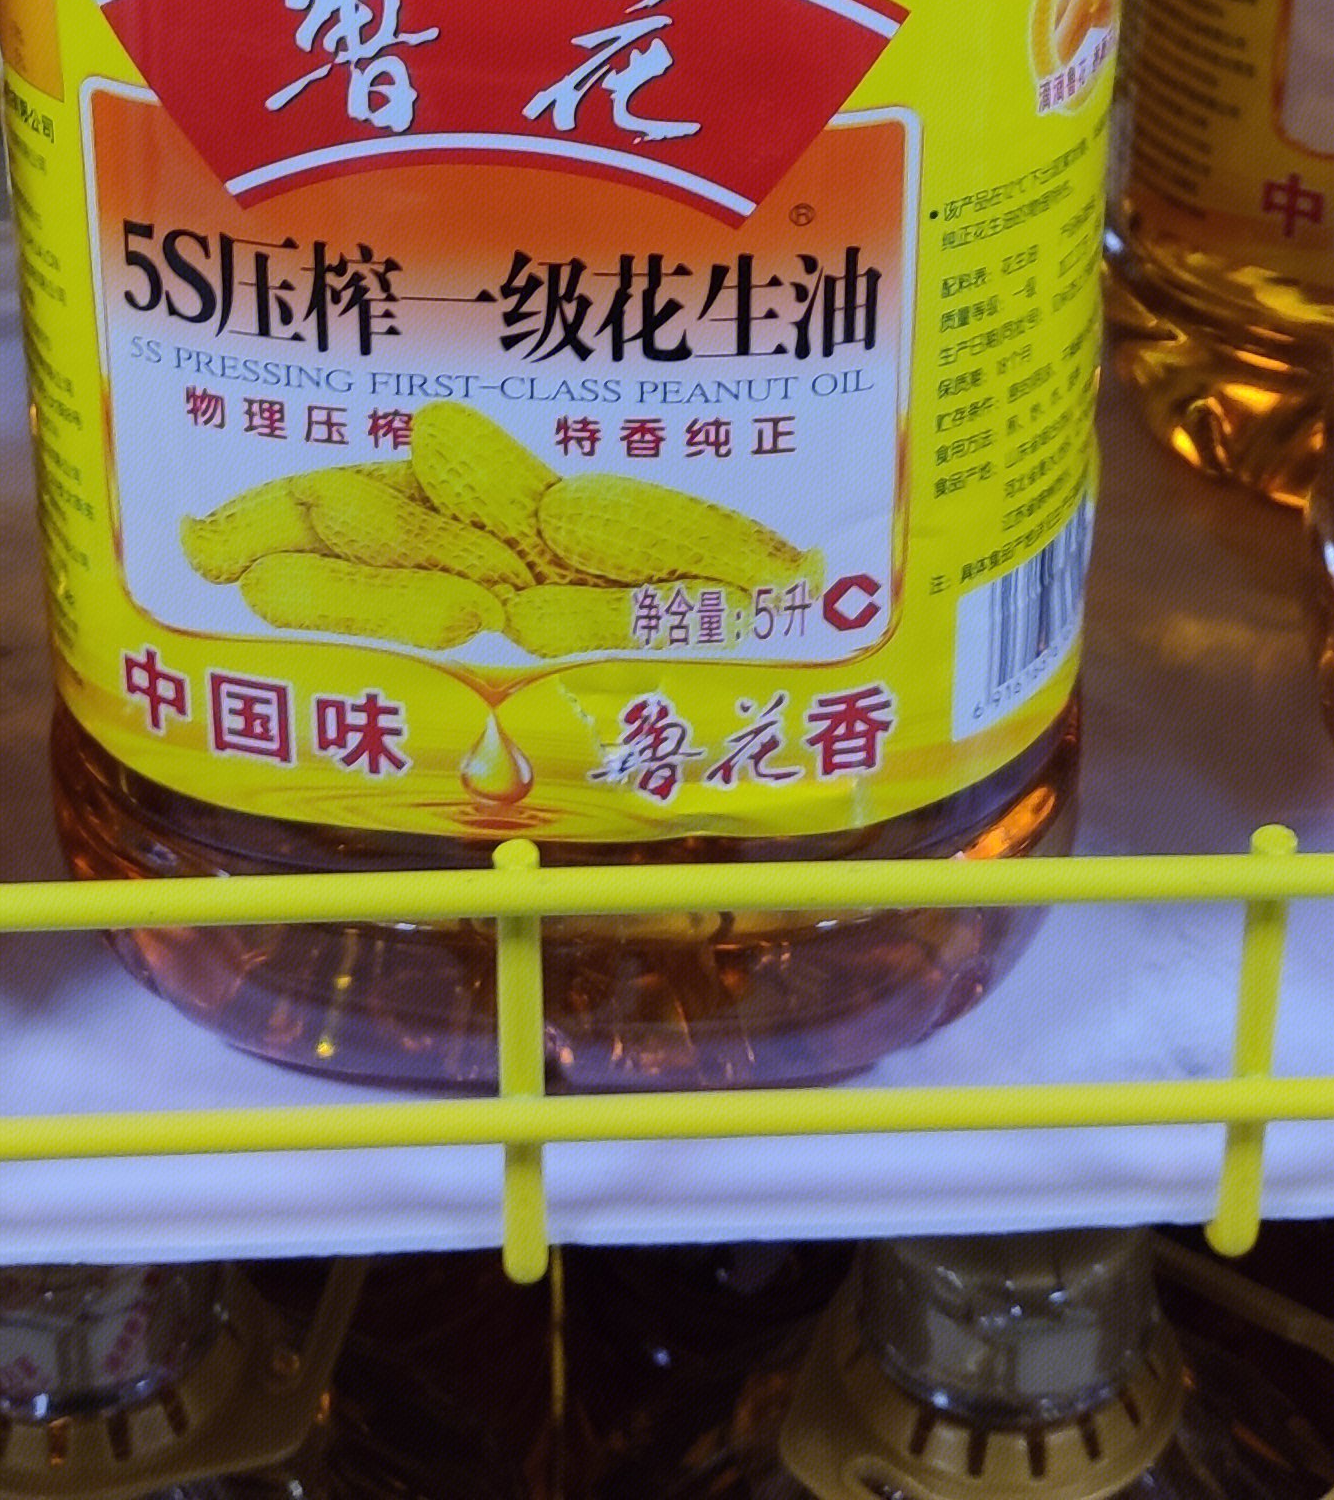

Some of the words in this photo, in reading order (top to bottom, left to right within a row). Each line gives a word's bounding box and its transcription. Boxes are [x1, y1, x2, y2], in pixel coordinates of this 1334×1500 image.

[1262, 172, 1325, 238] 中
[122, 217, 883, 364] 5S压榨一级花生油
[130, 334, 166, 366] 5S
[172, 344, 357, 393] PRESSING
[368, 367, 623, 404] FIRST-CLASS
[637, 372, 797, 404] PEANUT
[812, 367, 874, 395] OIL
[184, 386, 415, 449] 物理压榨
[555, 415, 797, 458] 特香纯正
[120, 646, 411, 775] 中国味
[591, 685, 896, 801] 鲁花香
